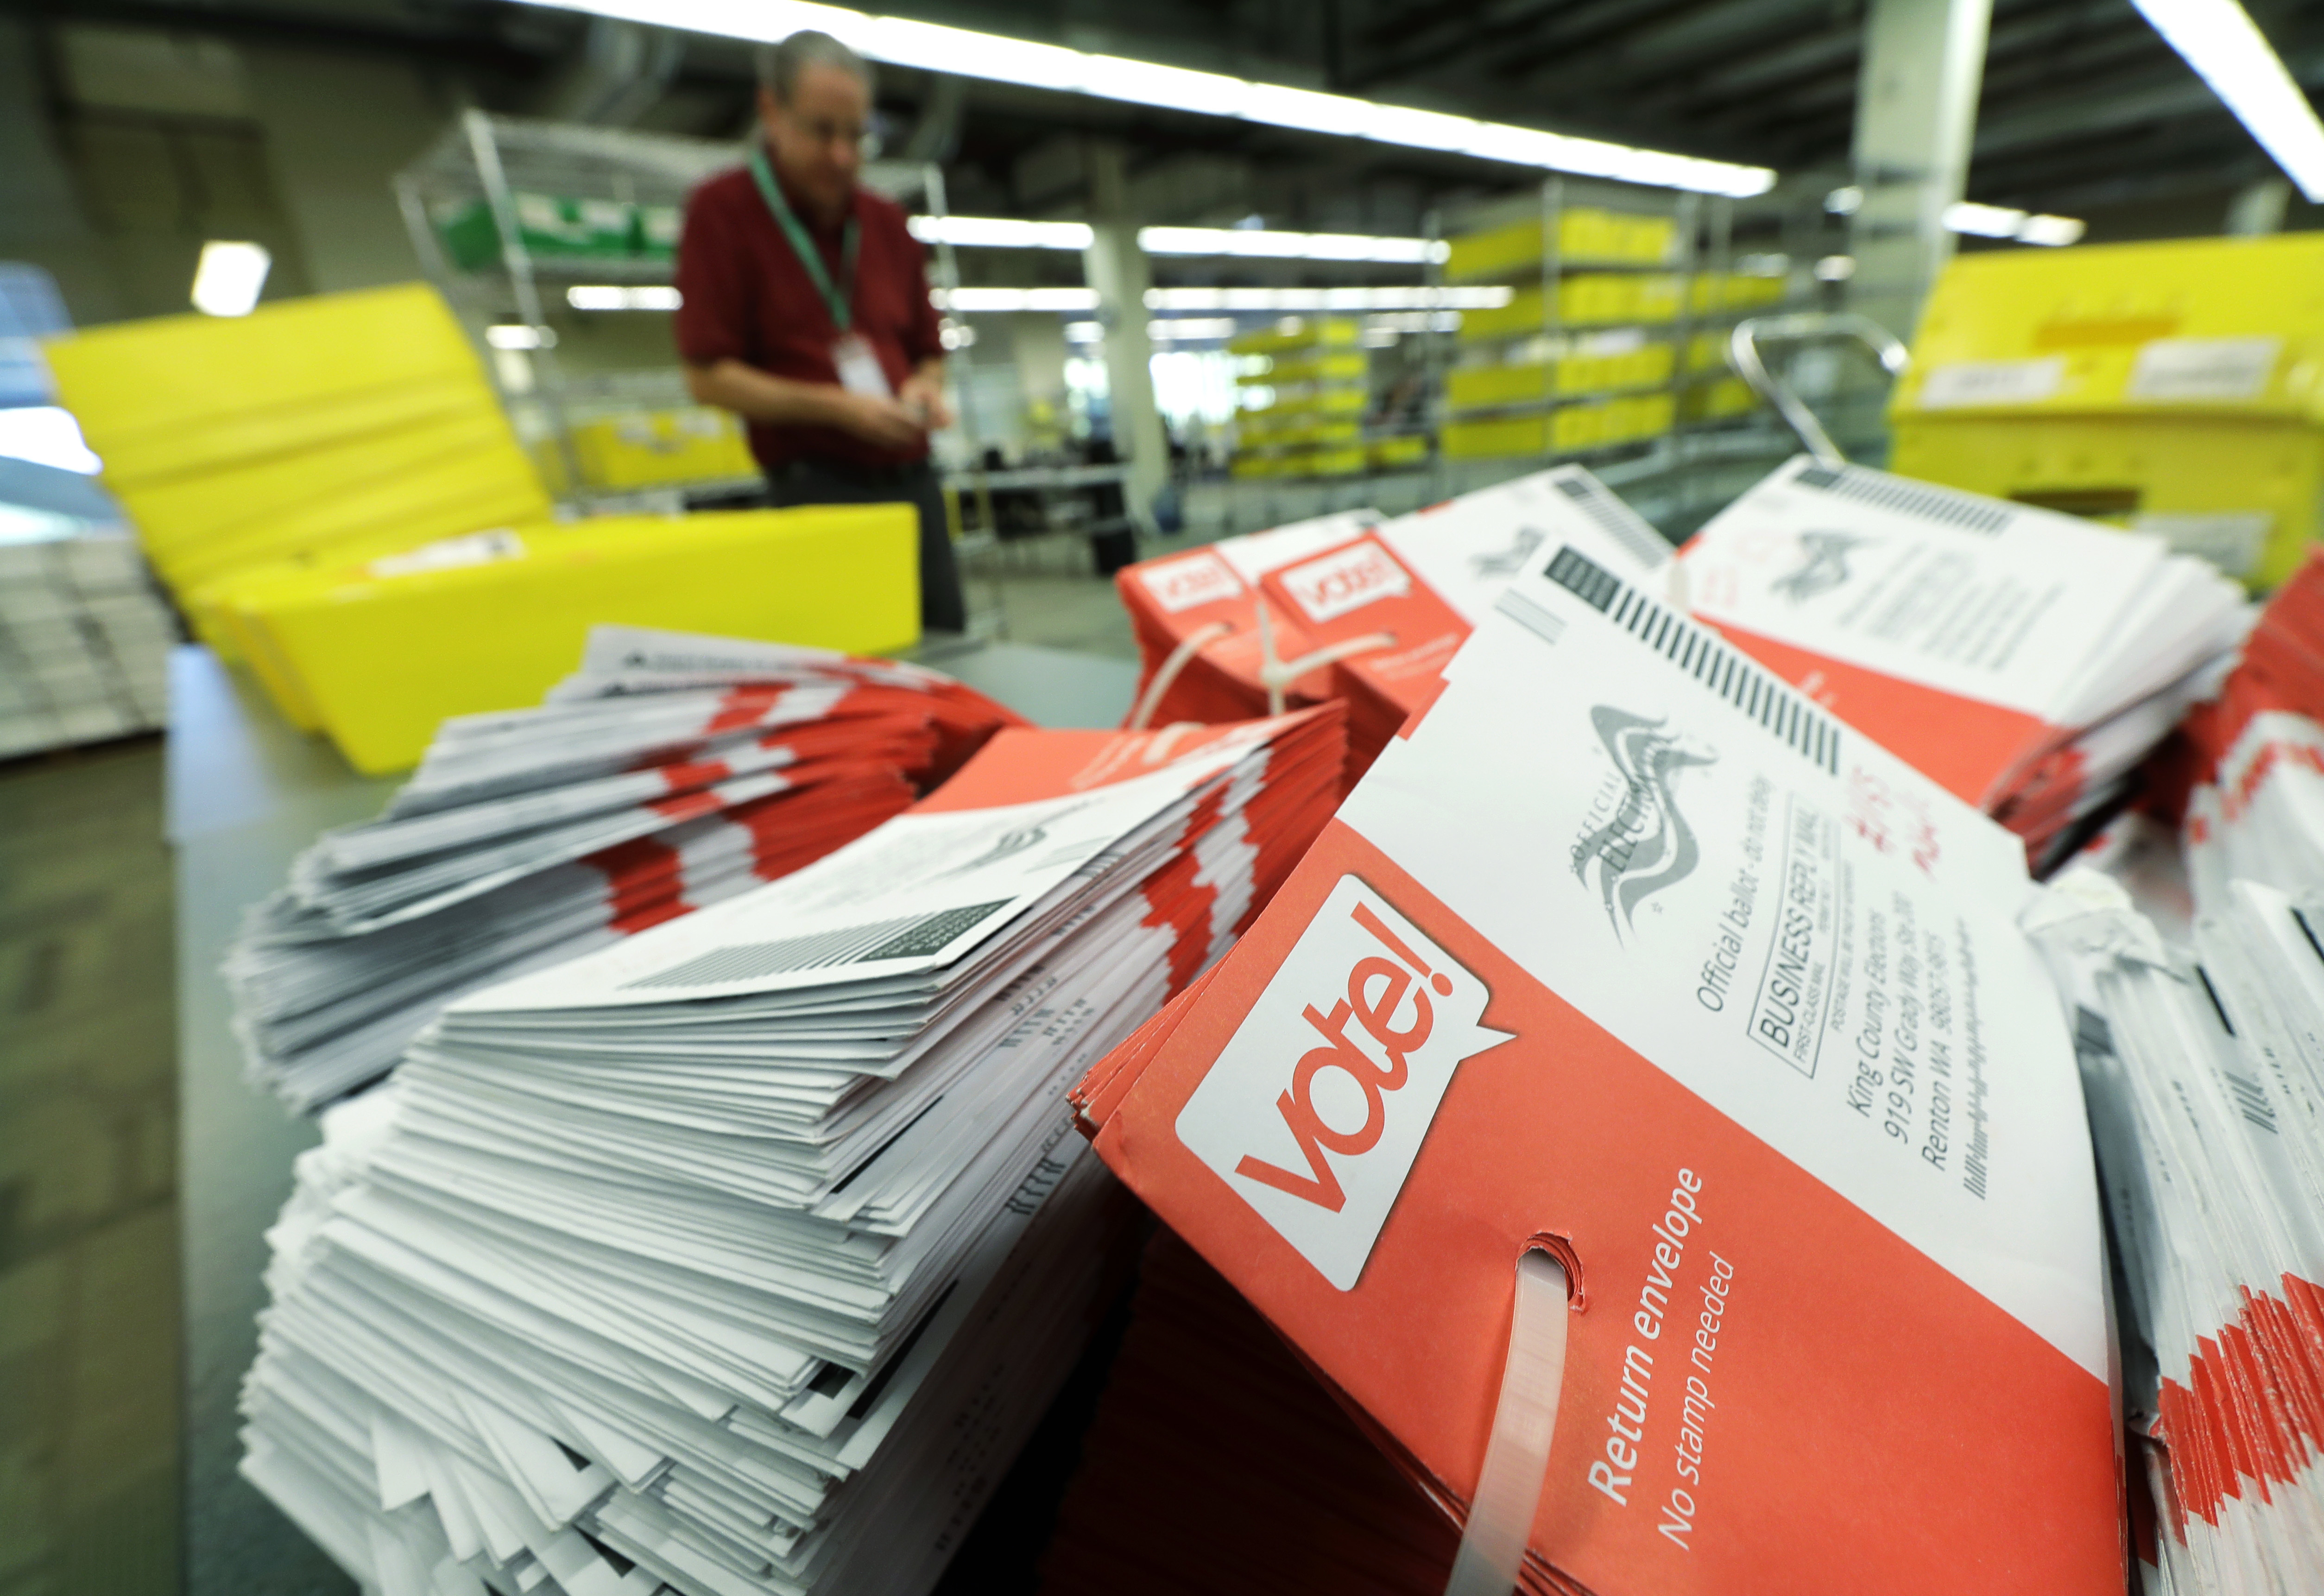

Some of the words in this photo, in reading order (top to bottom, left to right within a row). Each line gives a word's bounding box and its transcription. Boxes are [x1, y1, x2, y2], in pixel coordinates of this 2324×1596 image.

[1696, 922, 1744, 1013] Official
[1723, 868, 1759, 929] ballot
[1760, 907, 1813, 1048] BUSINESS
[1788, 847, 1817, 914] REPLY
[1234, 900, 1453, 1214] vote!
[1793, 982, 1822, 1062] FIRST-CLASS
[1855, 983, 1891, 1060] County
[1894, 993, 1926, 1052] Grady
[1929, 1039, 1952, 1080] WA
[1846, 1060, 1884, 1118] King
[1890, 1047, 1916, 1096] SW
[1884, 1090, 1912, 1145] 919
[1921, 1081, 1951, 1172] Renton
[1587, 1344, 1655, 1507] Return
[1634, 1167, 1704, 1341] envelope
[1689, 1250, 1735, 1374] needed
[1673, 1375, 1716, 1486] stamp
[1657, 1486, 1697, 1552] No
